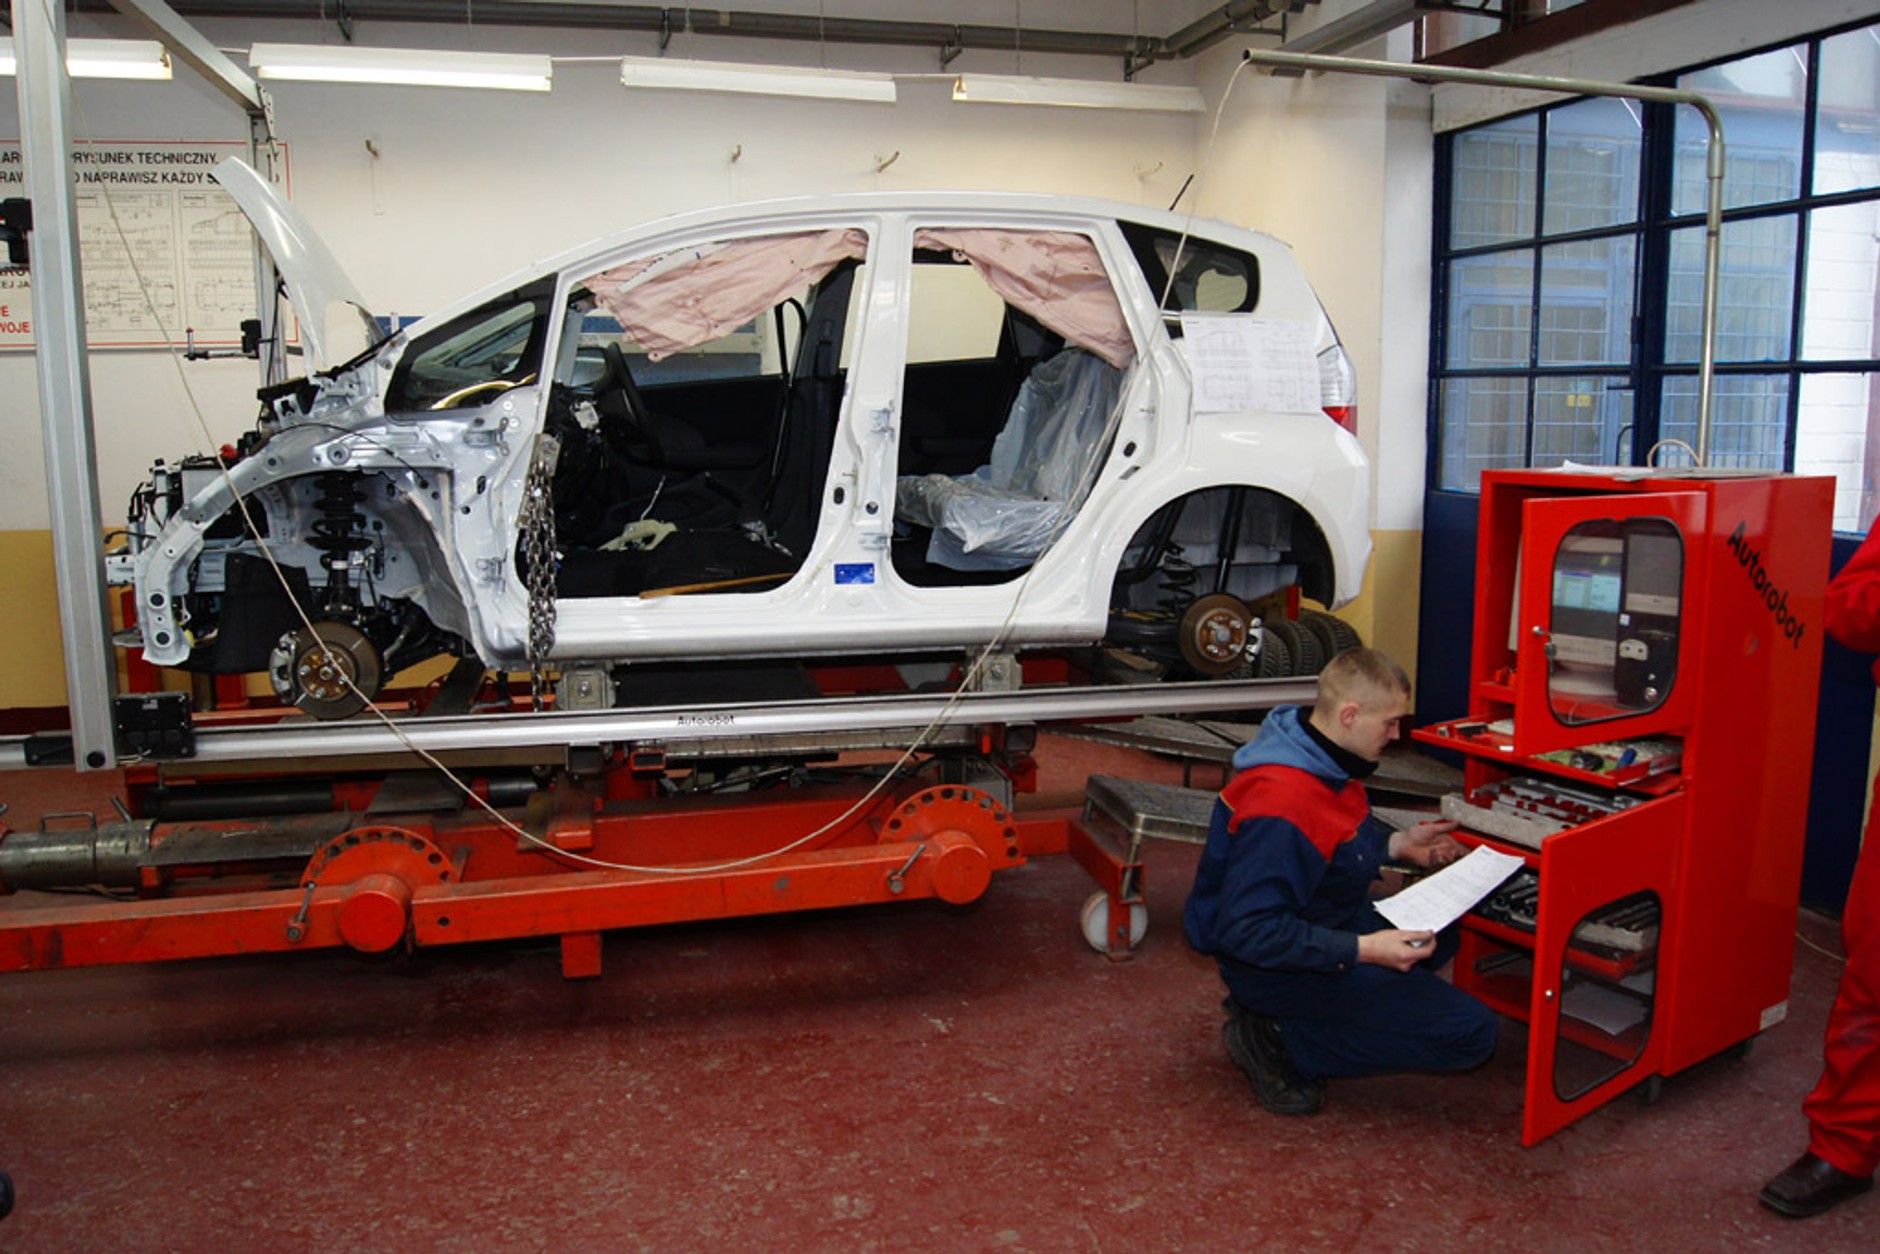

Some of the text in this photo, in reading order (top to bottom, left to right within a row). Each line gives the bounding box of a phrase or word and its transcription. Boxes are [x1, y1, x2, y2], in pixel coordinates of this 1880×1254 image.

[83, 171, 158, 184] NAPRAWISZ
[162, 170, 204, 184] KAŻDY
[1727, 521, 1805, 650] Autorobot
[677, 714, 734, 725] Autoobot
